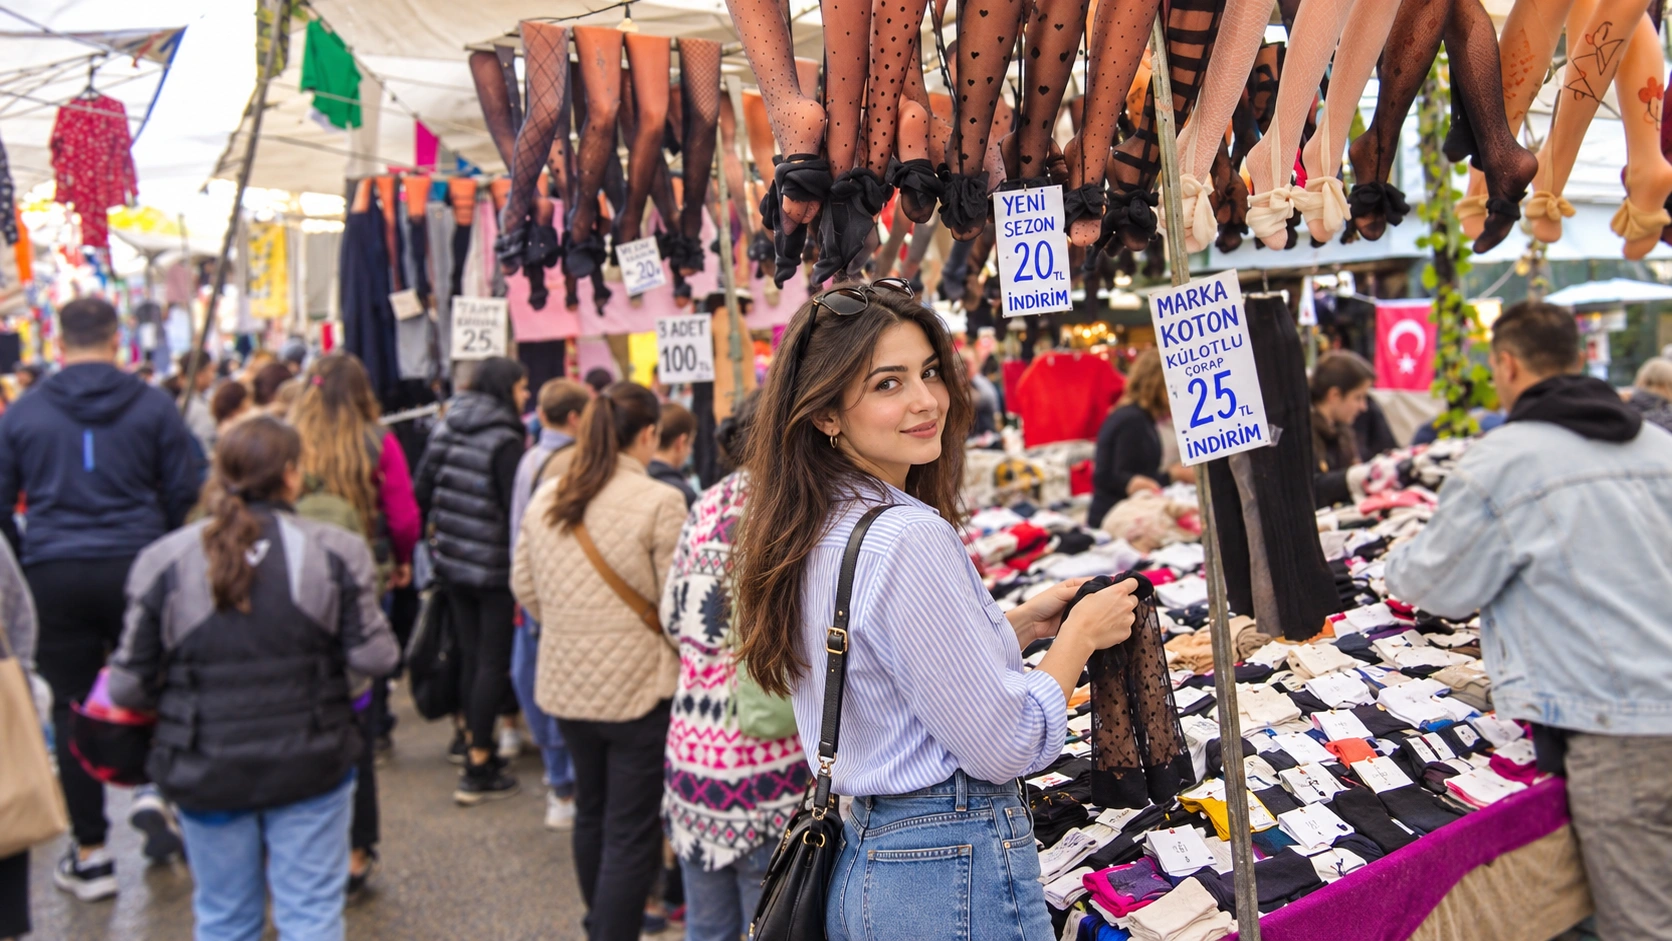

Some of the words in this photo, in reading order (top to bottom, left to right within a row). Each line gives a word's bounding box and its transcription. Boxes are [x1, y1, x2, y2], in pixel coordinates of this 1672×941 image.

[1002, 189, 1046, 217] YENİ
[1004, 216, 1055, 238] SEZON
[636, 260, 655, 280] 20
[1013, 240, 1054, 283] 20
[1053, 271, 1065, 281] TL
[1008, 287, 1068, 311] İNDİRİM
[1157, 280, 1228, 319] MARKA
[462, 328, 492, 352] 25
[658, 320, 667, 339] 3
[670, 319, 706, 337] ADET
[1160, 304, 1239, 348] KOTON
[661, 344, 697, 373] 100
[1166, 333, 1243, 369] KÜLOTLU
[1185, 358, 1224, 377] ÇORAP
[1187, 370, 1237, 428] 25
[1239, 404, 1253, 417] TL
[1186, 423, 1262, 459] İNDİRİM
